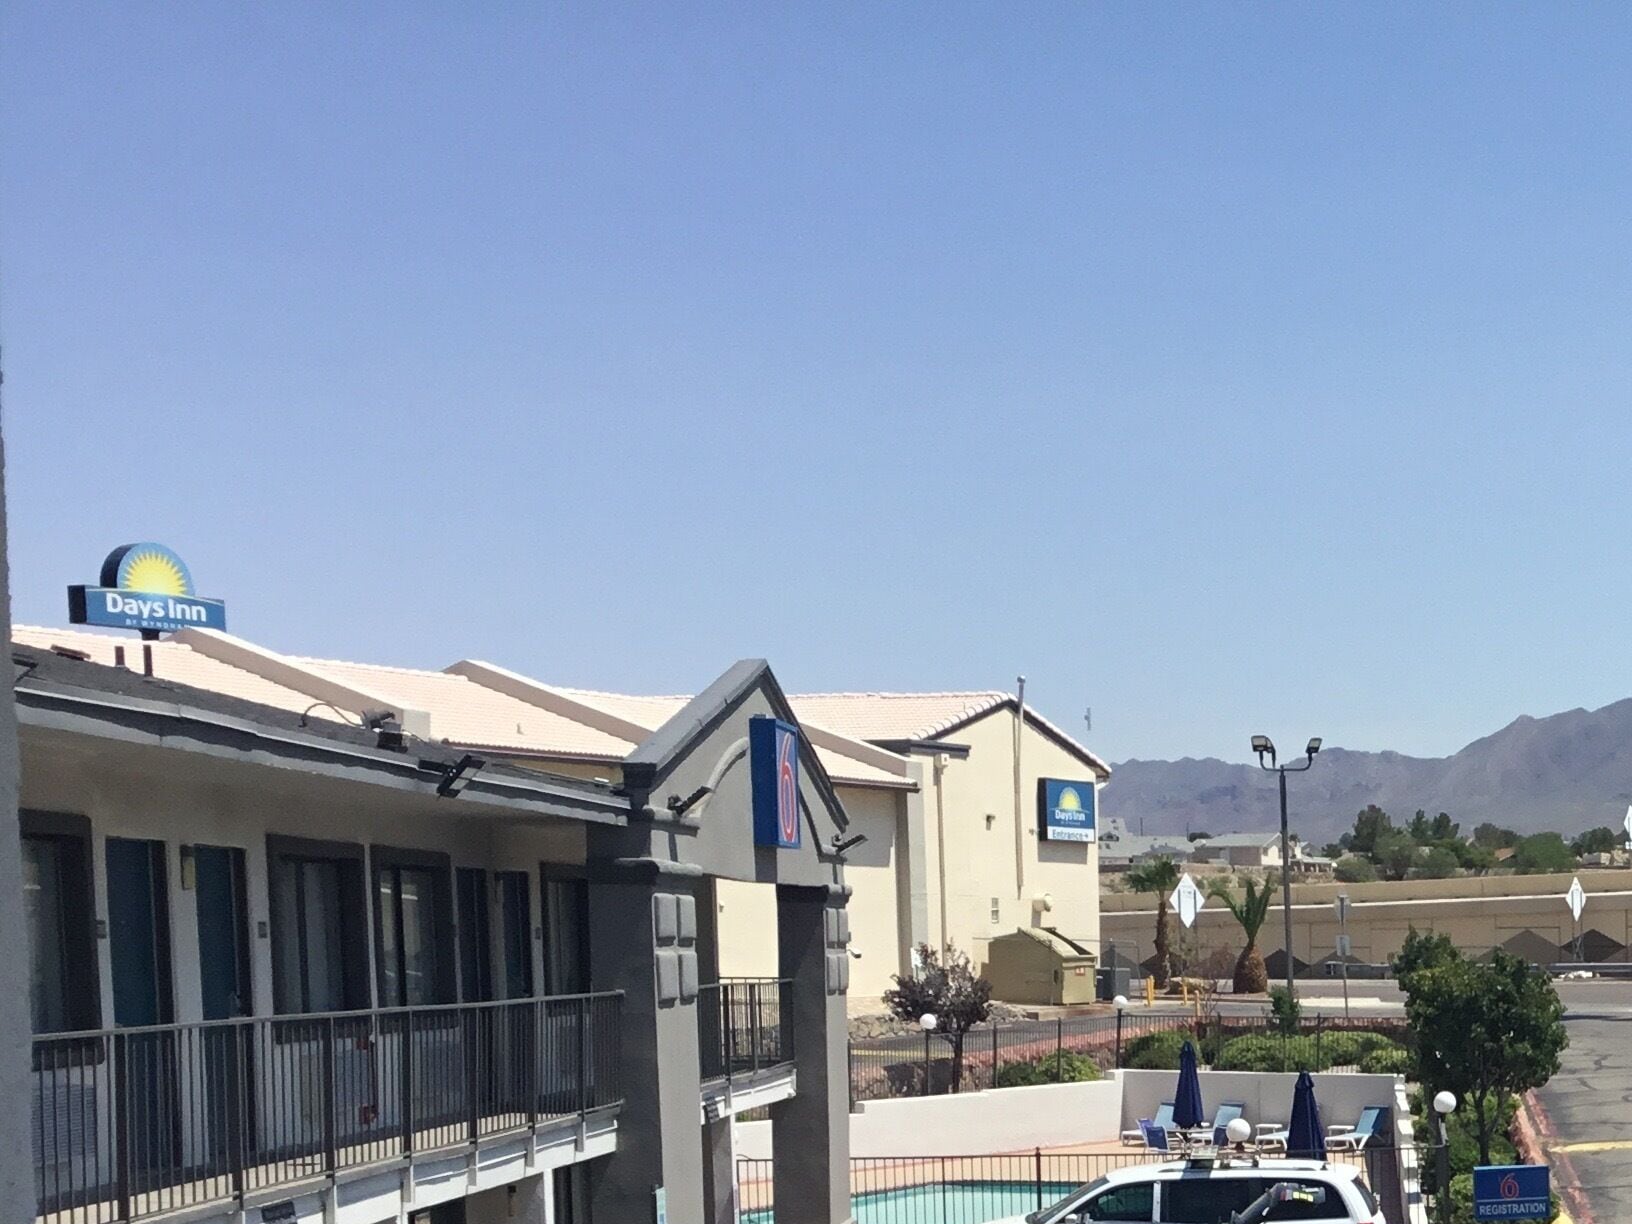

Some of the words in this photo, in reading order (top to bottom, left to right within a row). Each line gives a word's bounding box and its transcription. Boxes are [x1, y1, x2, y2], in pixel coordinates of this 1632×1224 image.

[106, 592, 165, 619] Days
[168, 599, 207, 622] Inn
[780, 732, 796, 843] 6
[1052, 829, 1083, 840] Entrance
[1500, 1172, 1520, 1200] 6
[1479, 1202, 1547, 1216] REGISTRATION
